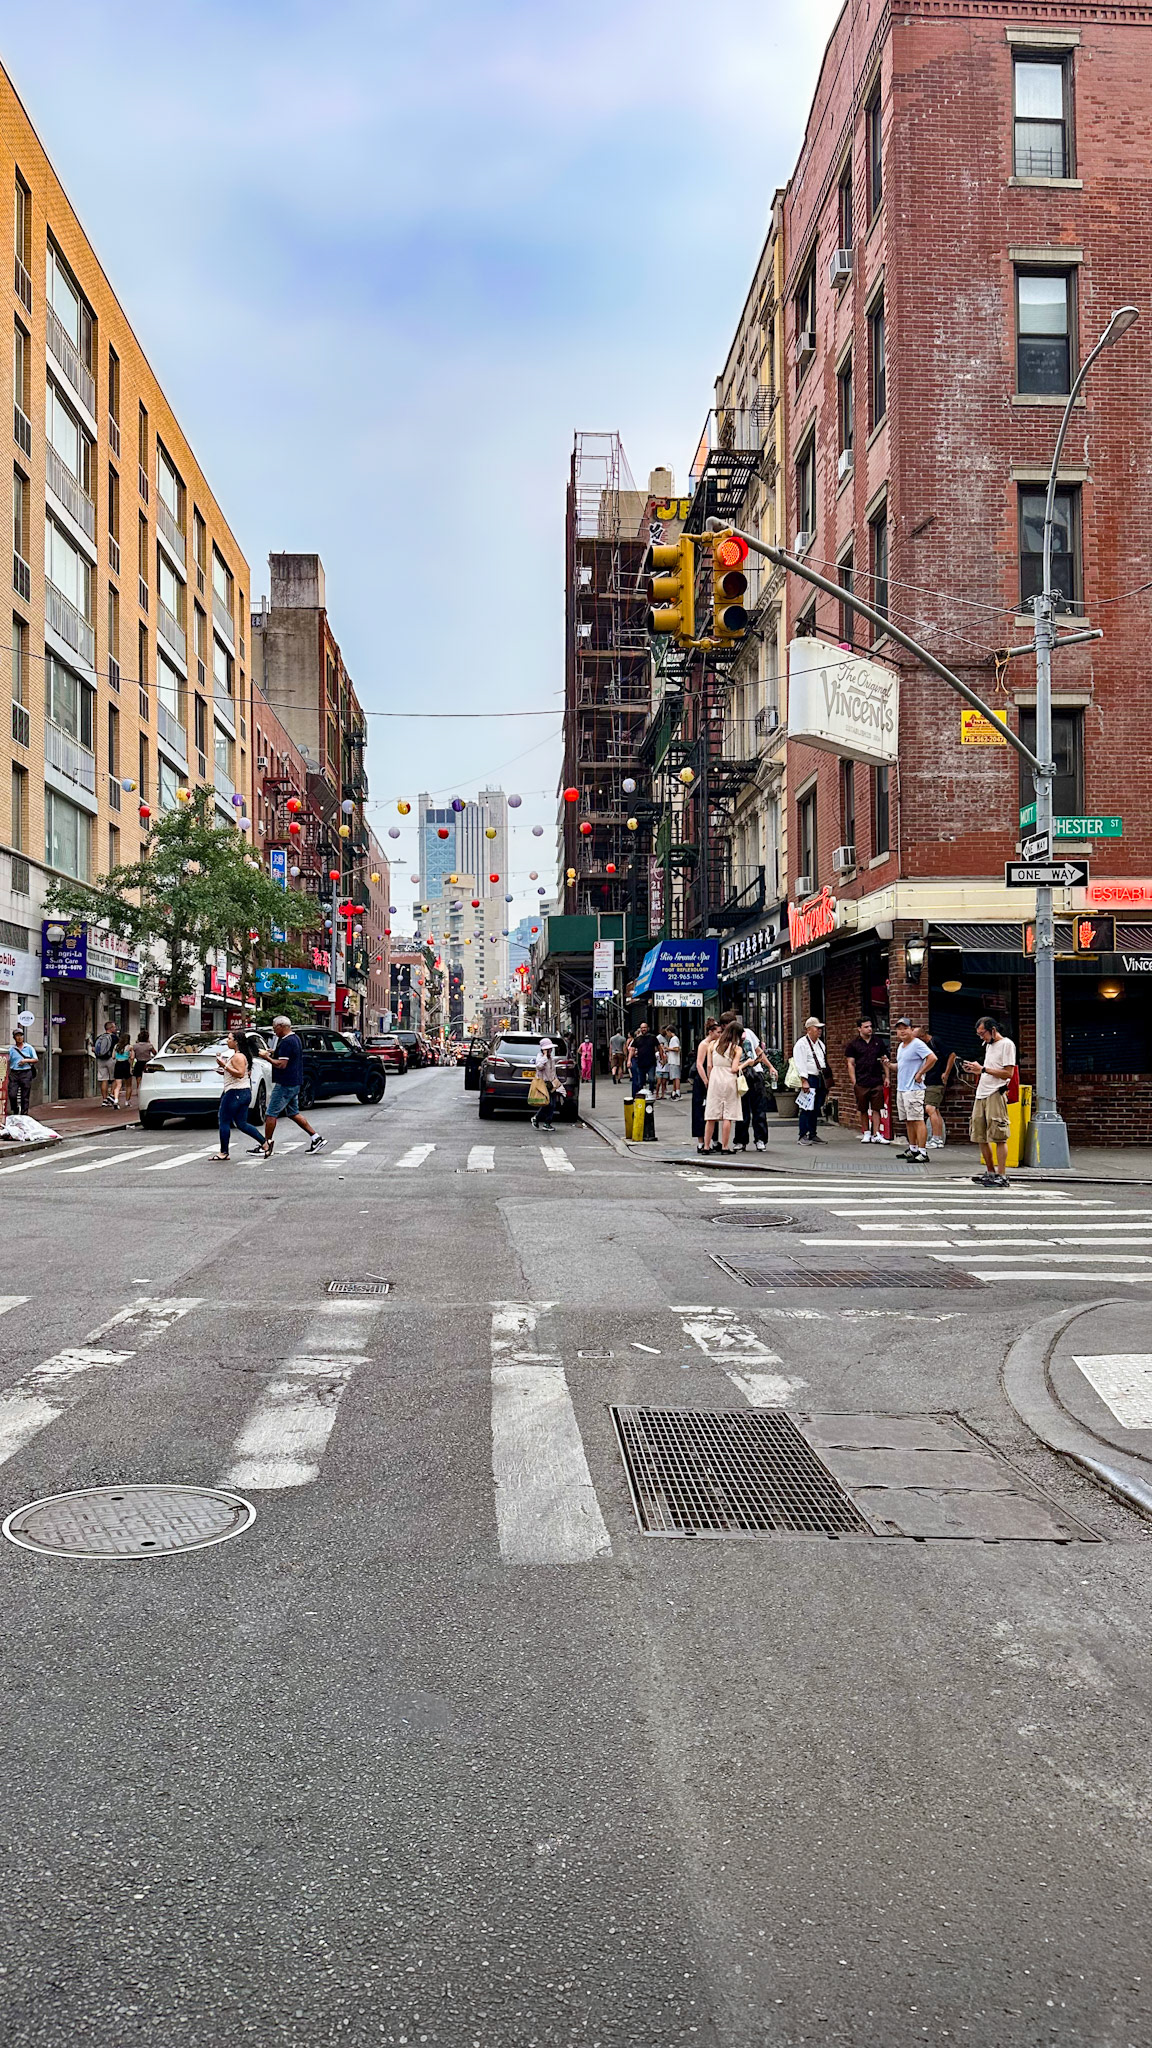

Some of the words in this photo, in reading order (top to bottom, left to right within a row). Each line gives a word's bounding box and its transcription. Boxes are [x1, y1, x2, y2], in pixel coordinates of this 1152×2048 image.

[838, 664, 856, 682] The
[857, 670, 893, 700] Original
[1020, 806, 1034, 823] MOTT
[1057, 819, 1103, 834] HESTER
[1111, 819, 1119, 828] ST
[1025, 845, 1033, 856] ONE
[1036, 840, 1046, 851] WAY
[1018, 870, 1041, 880] ONE
[1052, 870, 1076, 880] WAY
[675, 952, 696, 961] Grande
[697, 951, 710, 963] Spa
